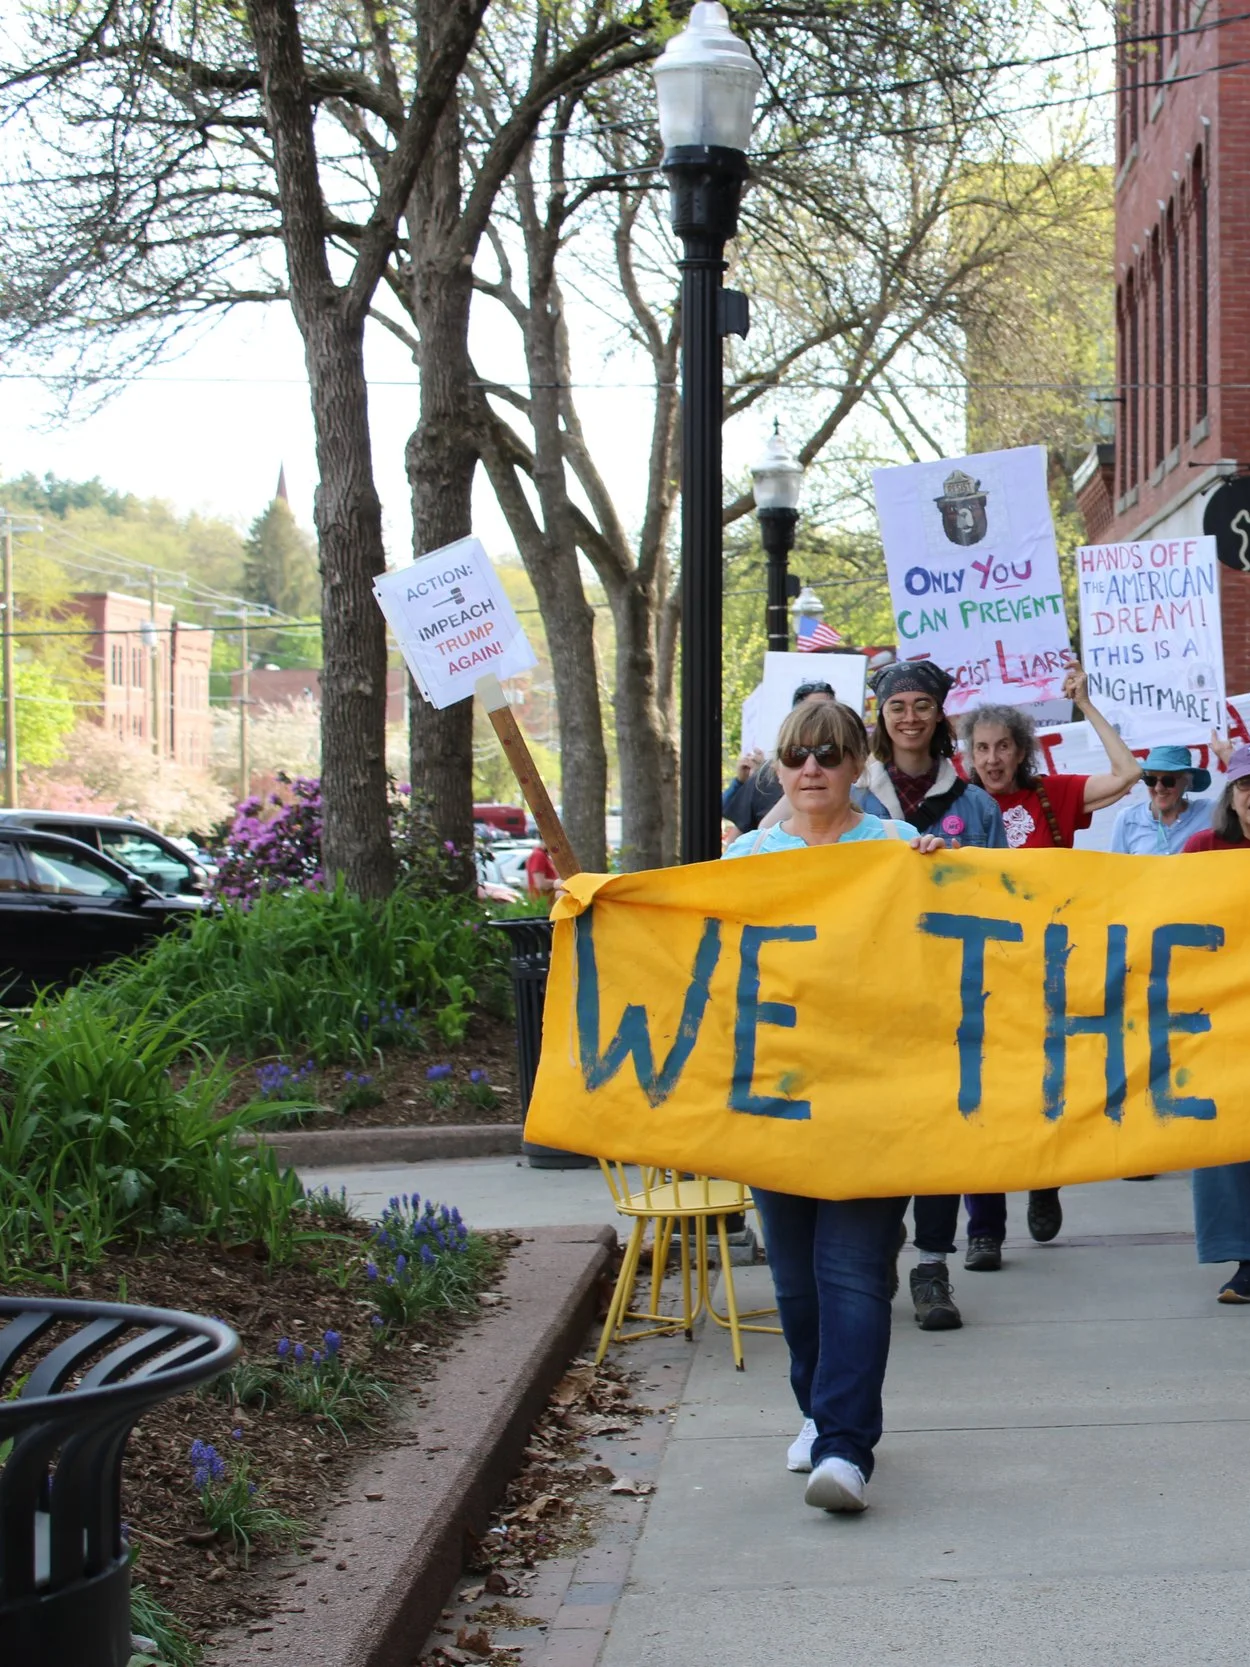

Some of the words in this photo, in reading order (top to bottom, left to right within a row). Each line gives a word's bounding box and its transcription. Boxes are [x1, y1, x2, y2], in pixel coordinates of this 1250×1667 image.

[904, 566, 965, 596] ONLY
[970, 554, 1032, 590] YOU
[1081, 544, 1143, 572] HANDS
[1150, 540, 1197, 568] OFF
[406, 564, 473, 602] ACTION:
[1083, 581, 1105, 594] THE
[1105, 563, 1214, 606] AMERICAN
[418, 598, 495, 642] IMPEACH
[897, 608, 949, 639] CAN
[958, 594, 1064, 630] PREVENT
[435, 621, 494, 657] TRUMP
[448, 641, 504, 675] AGAIN!
[1088, 643, 1144, 667] THIS
[1154, 639, 1170, 661] IS
[1182, 637, 1199, 658] A
[1088, 672, 1221, 731] NIGHTMARE!
[575, 904, 818, 1121] WE
[918, 912, 1224, 1125] THE
